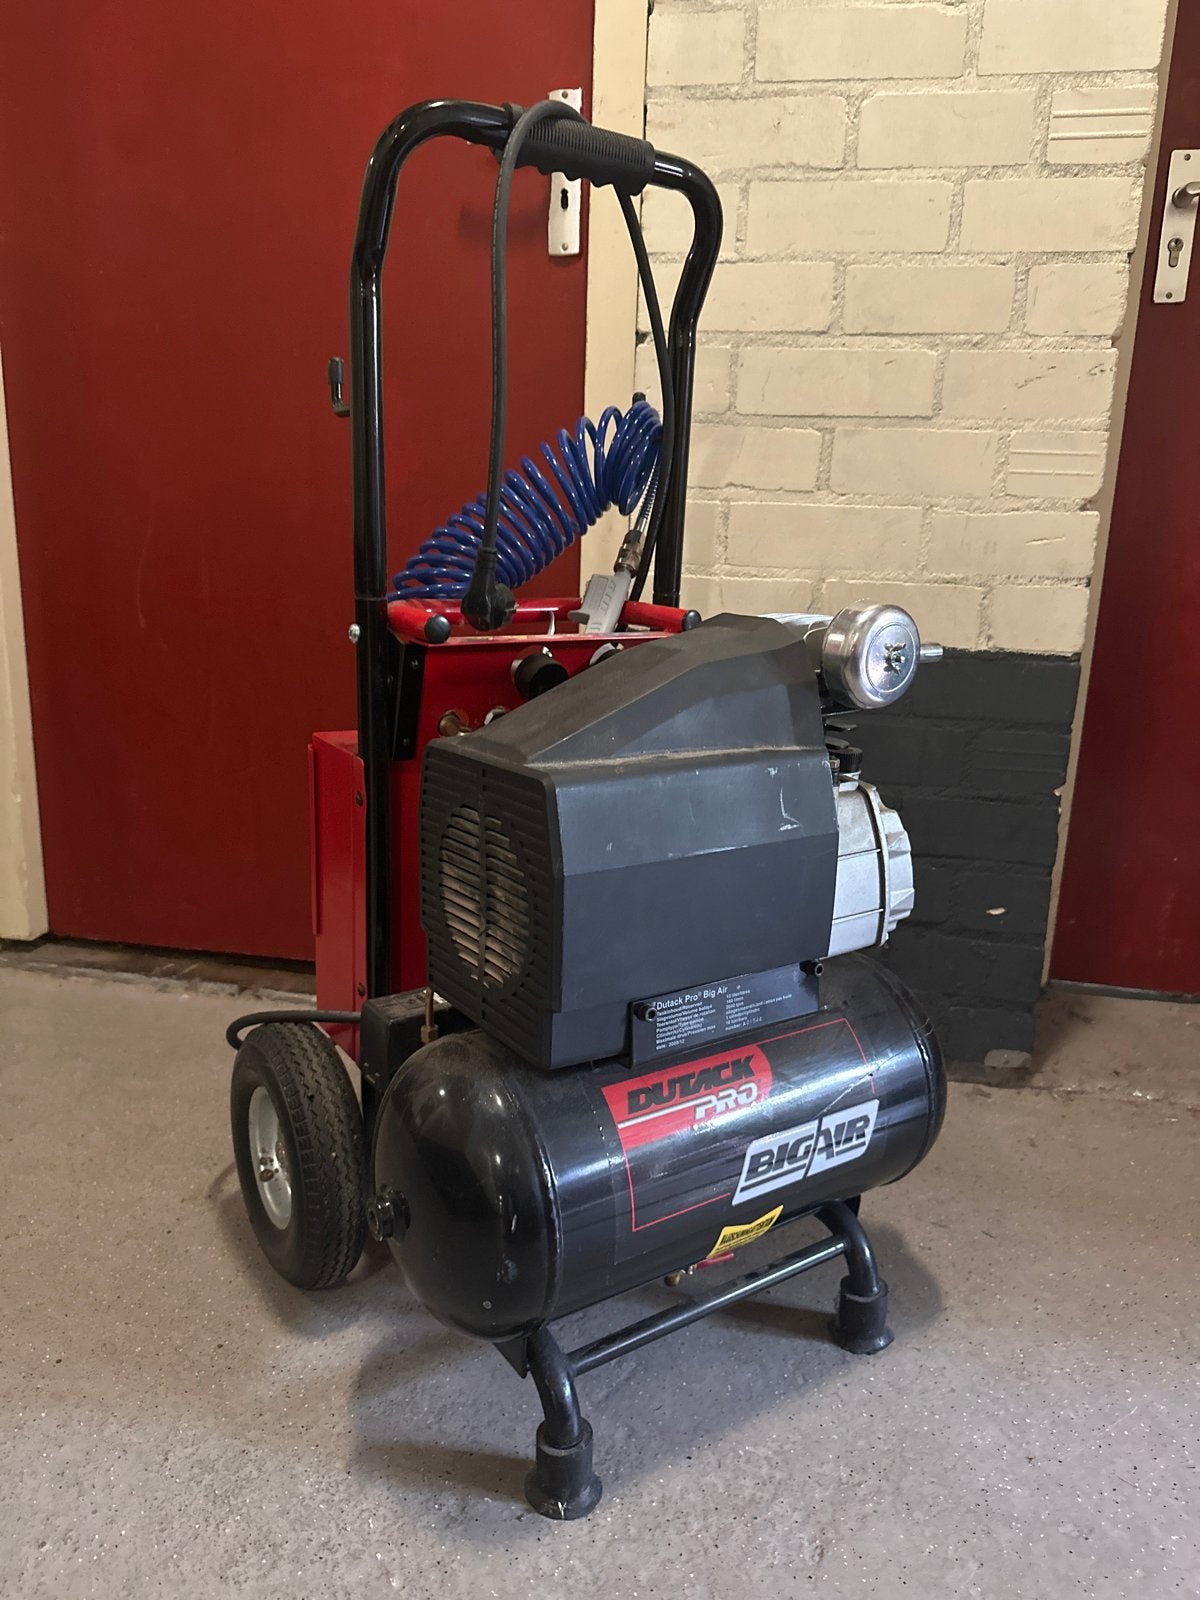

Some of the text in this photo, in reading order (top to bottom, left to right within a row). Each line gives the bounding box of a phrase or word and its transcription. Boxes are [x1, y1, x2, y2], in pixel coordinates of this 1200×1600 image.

[657, 998, 683, 1010] Dutack
[703, 989, 716, 999] Big
[717, 986, 728, 995] Air
[627, 1054, 755, 1115] DUTACK
[694, 1082, 758, 1121] PRO
